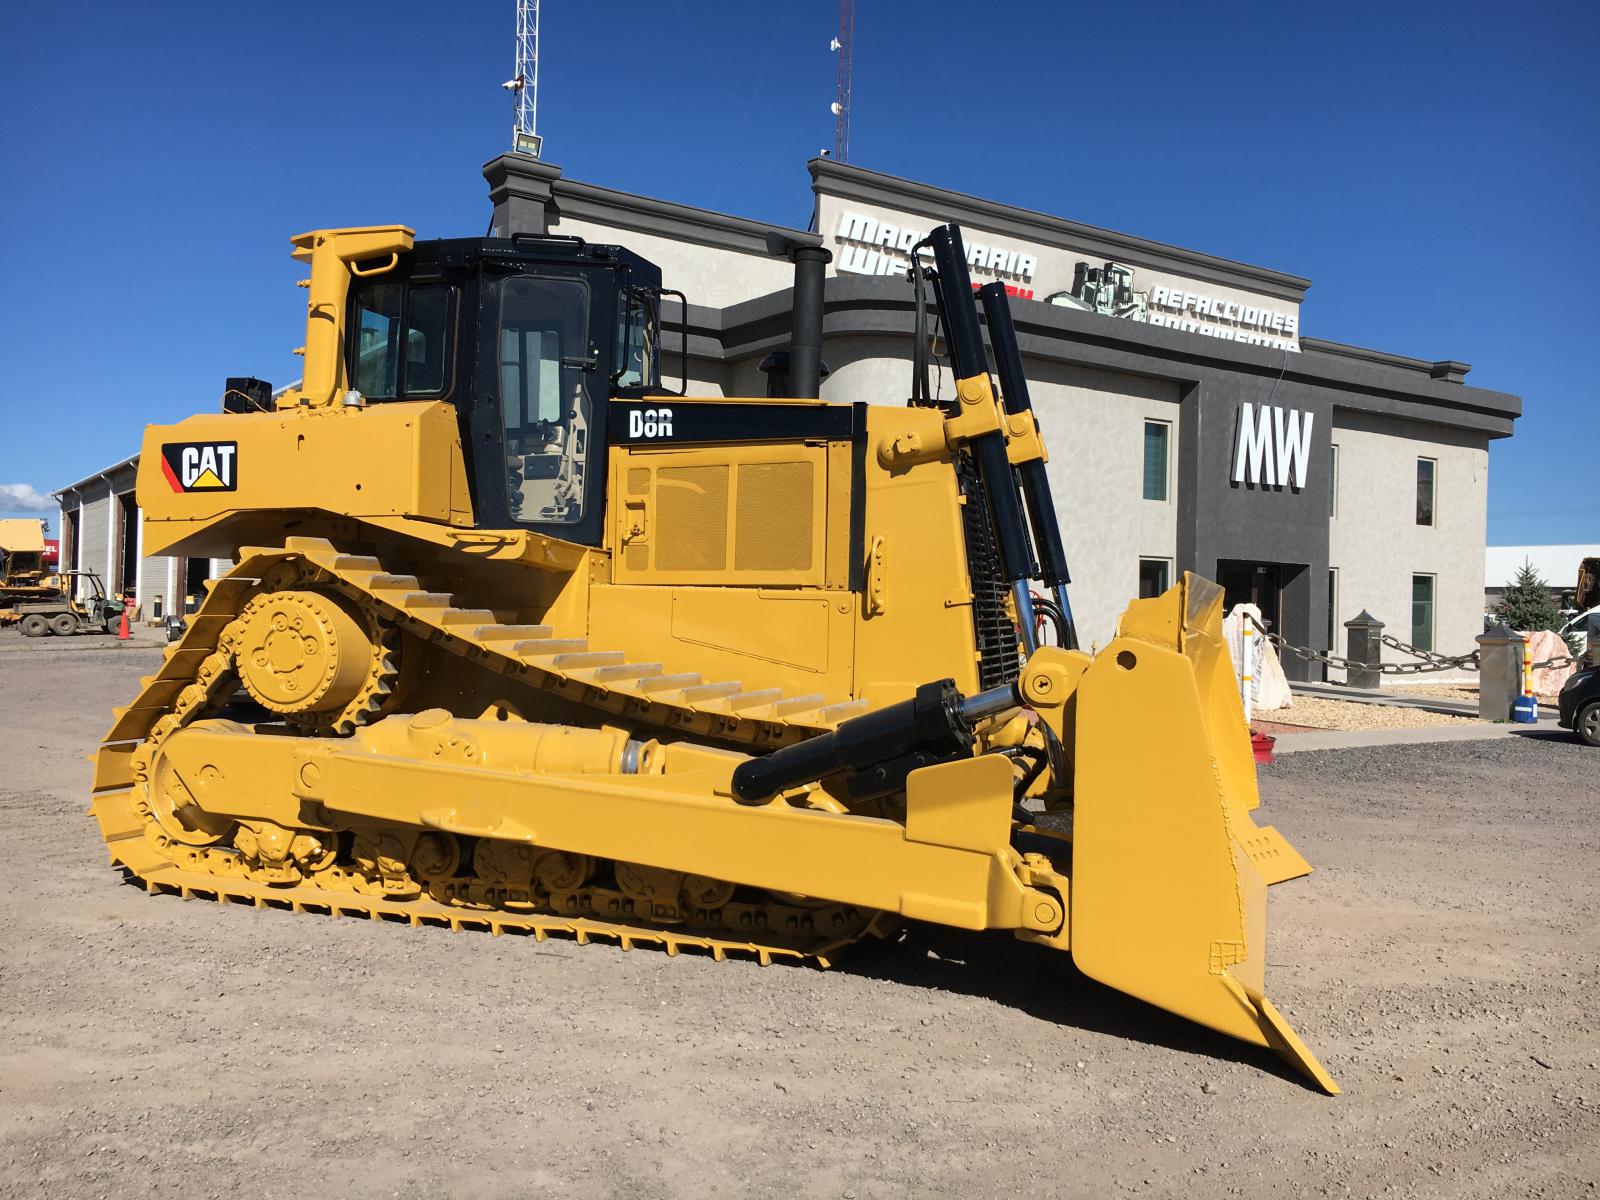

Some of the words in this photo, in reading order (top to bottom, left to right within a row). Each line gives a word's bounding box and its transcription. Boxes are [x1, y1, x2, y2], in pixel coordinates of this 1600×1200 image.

[837, 211, 1038, 277] MAQARIA
[1152, 286, 1299, 333] REFACCIONES
[629, 408, 673, 438] D8R
[1235, 402, 1314, 488] MW
[182, 445, 235, 488] CAT
